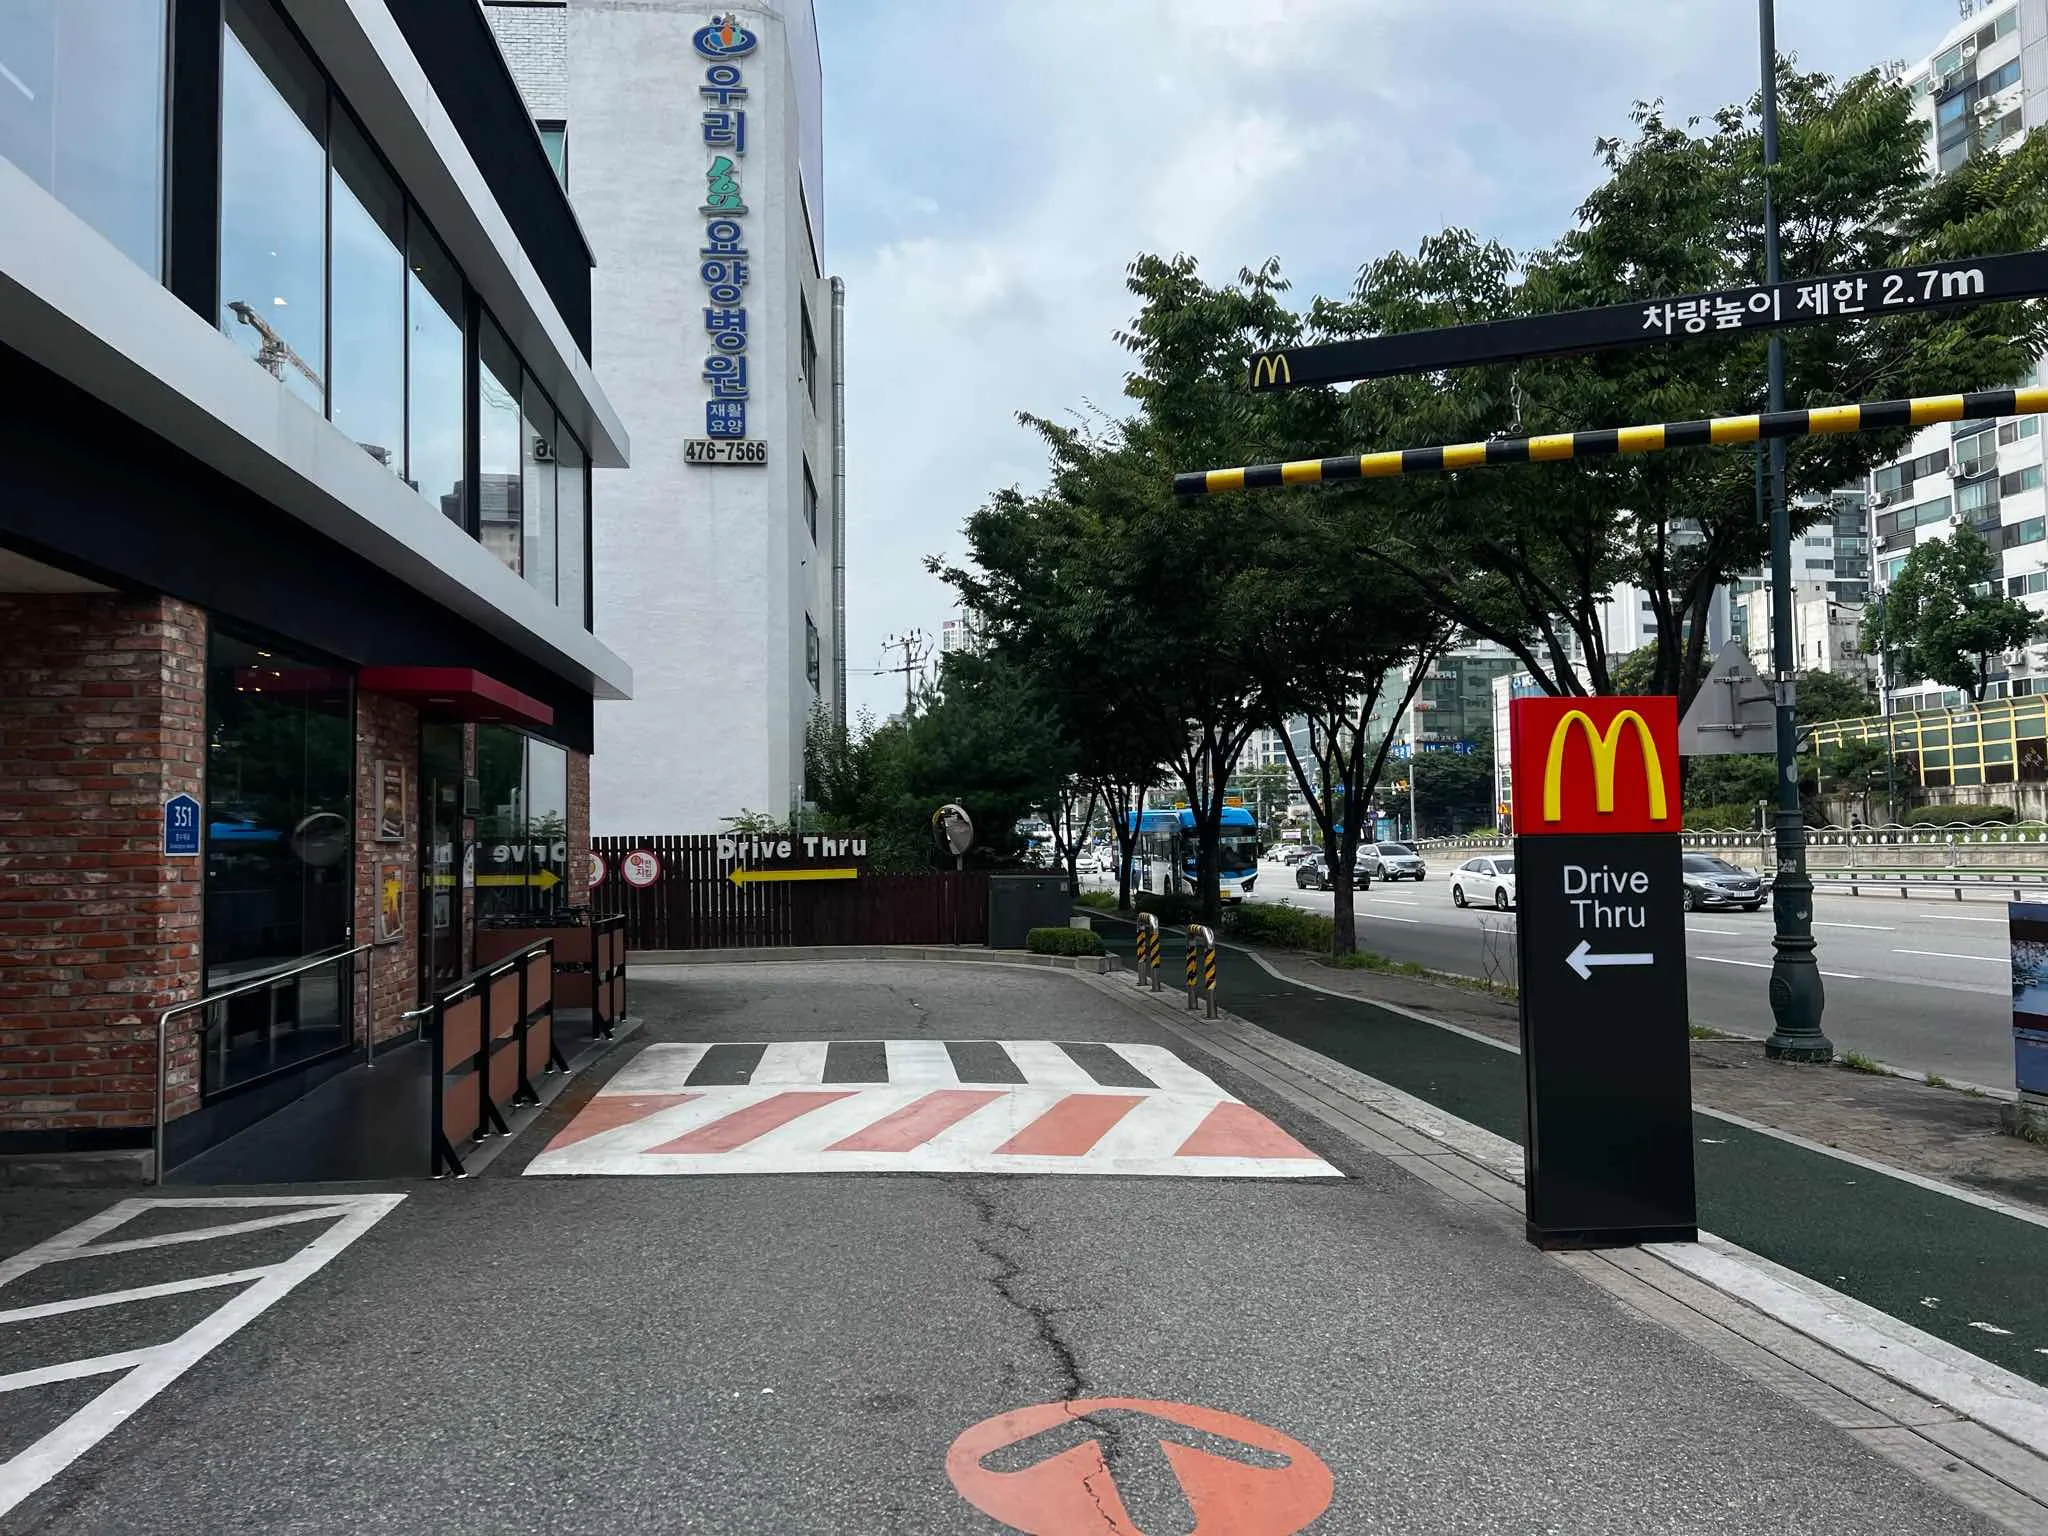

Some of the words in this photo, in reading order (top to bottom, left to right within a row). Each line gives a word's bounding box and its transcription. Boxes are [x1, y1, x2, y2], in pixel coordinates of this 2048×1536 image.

[1641, 288, 1780, 335] 차량높이
[1796, 277, 1868, 316] 제한
[1881, 268, 1985, 305] 2.7m
[709, 403, 743, 418] 재활
[710, 419, 743, 434] 요양
[686, 441, 766, 461] 476-7566
[174, 805, 192, 827] 351
[717, 835, 792, 860] Drive
[802, 836, 867, 858] Thru
[1563, 865, 1650, 894] Drive
[1570, 899, 1646, 929] Thru
